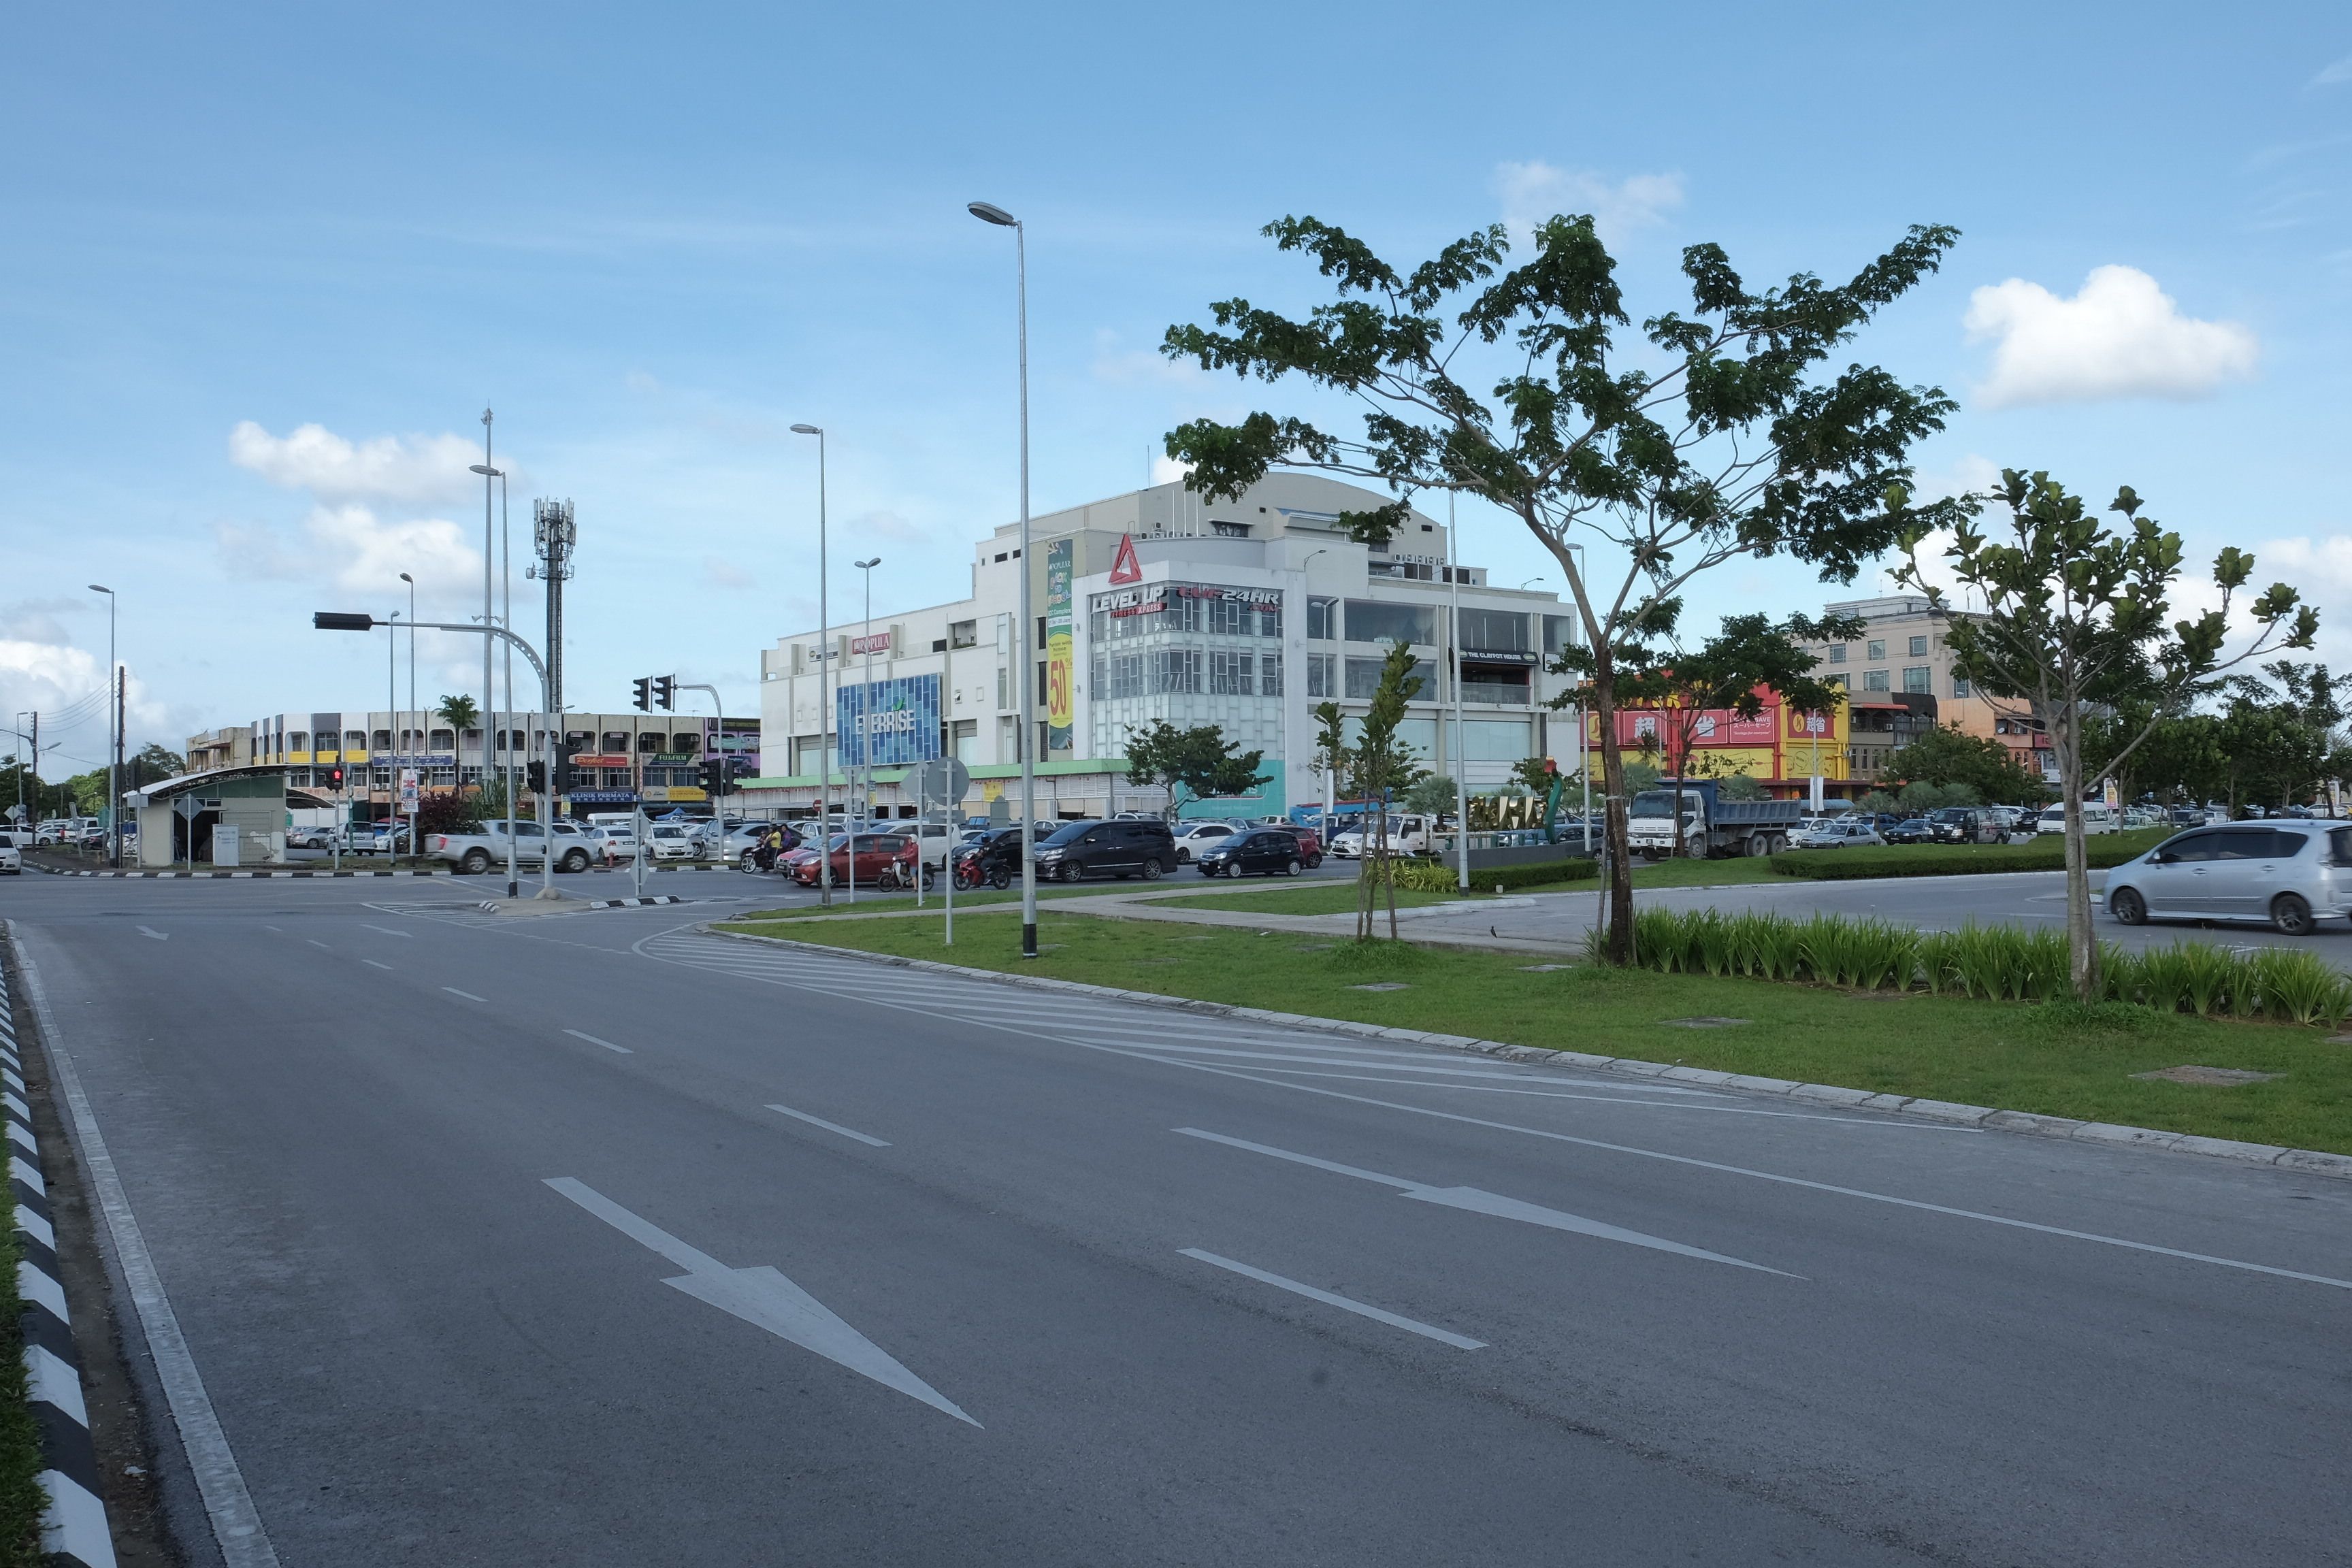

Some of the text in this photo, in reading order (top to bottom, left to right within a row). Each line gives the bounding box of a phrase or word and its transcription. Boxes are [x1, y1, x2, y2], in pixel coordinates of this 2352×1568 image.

[1092, 586, 1164, 612] LEVEL UP
[1137, 603, 1162, 615] XPRESS
[855, 709, 915, 735] EERRISE
